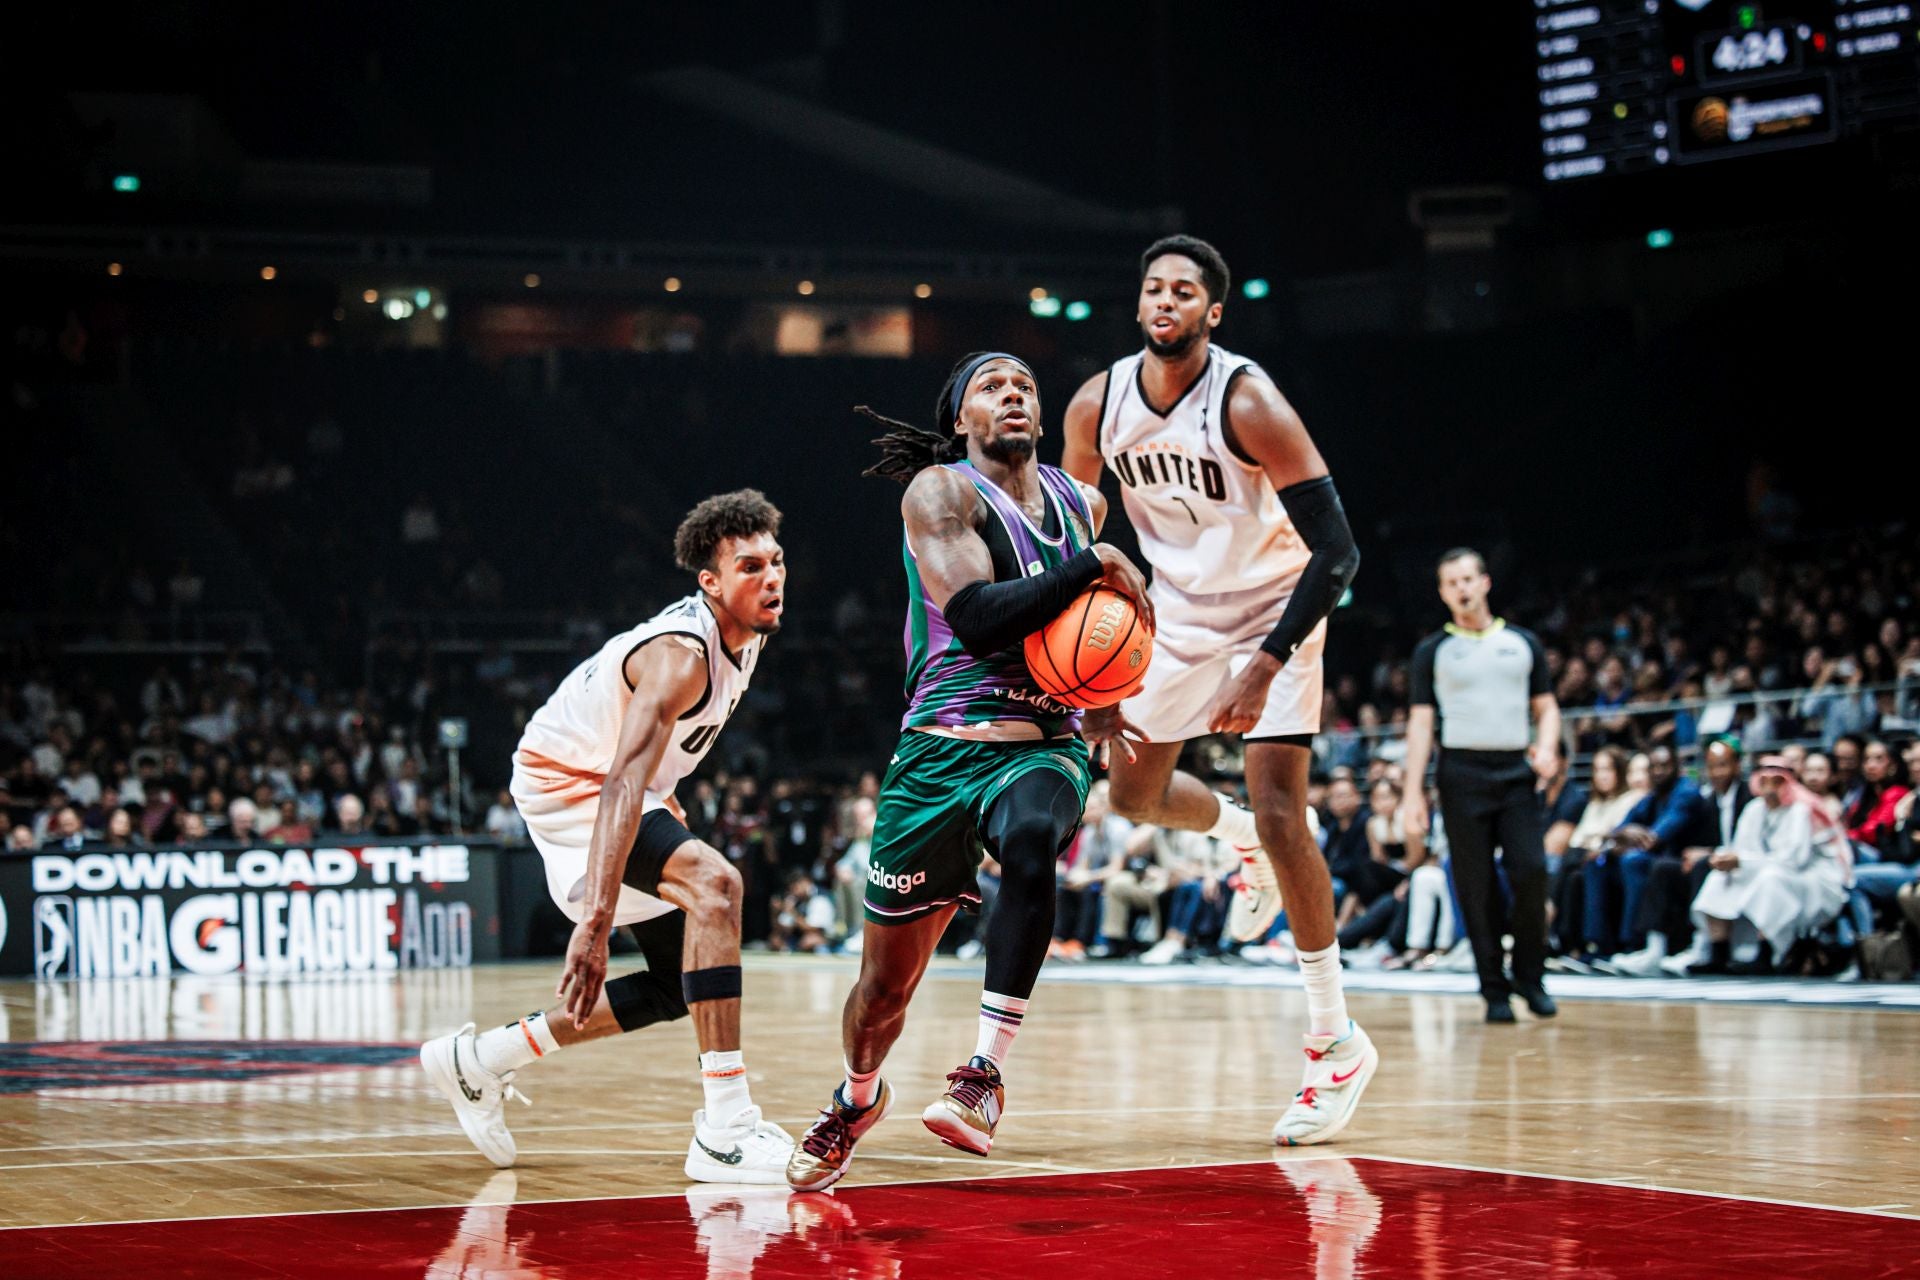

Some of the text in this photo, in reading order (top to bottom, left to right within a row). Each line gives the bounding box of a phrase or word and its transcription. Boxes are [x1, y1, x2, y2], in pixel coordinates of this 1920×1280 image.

[1114, 451, 1226, 501] UNITED
[32, 845, 470, 892] DOWNLOAD THE
[77, 895, 170, 977] NBA
[170, 893, 243, 975] G
[243, 888, 398, 973] LEAGUE
